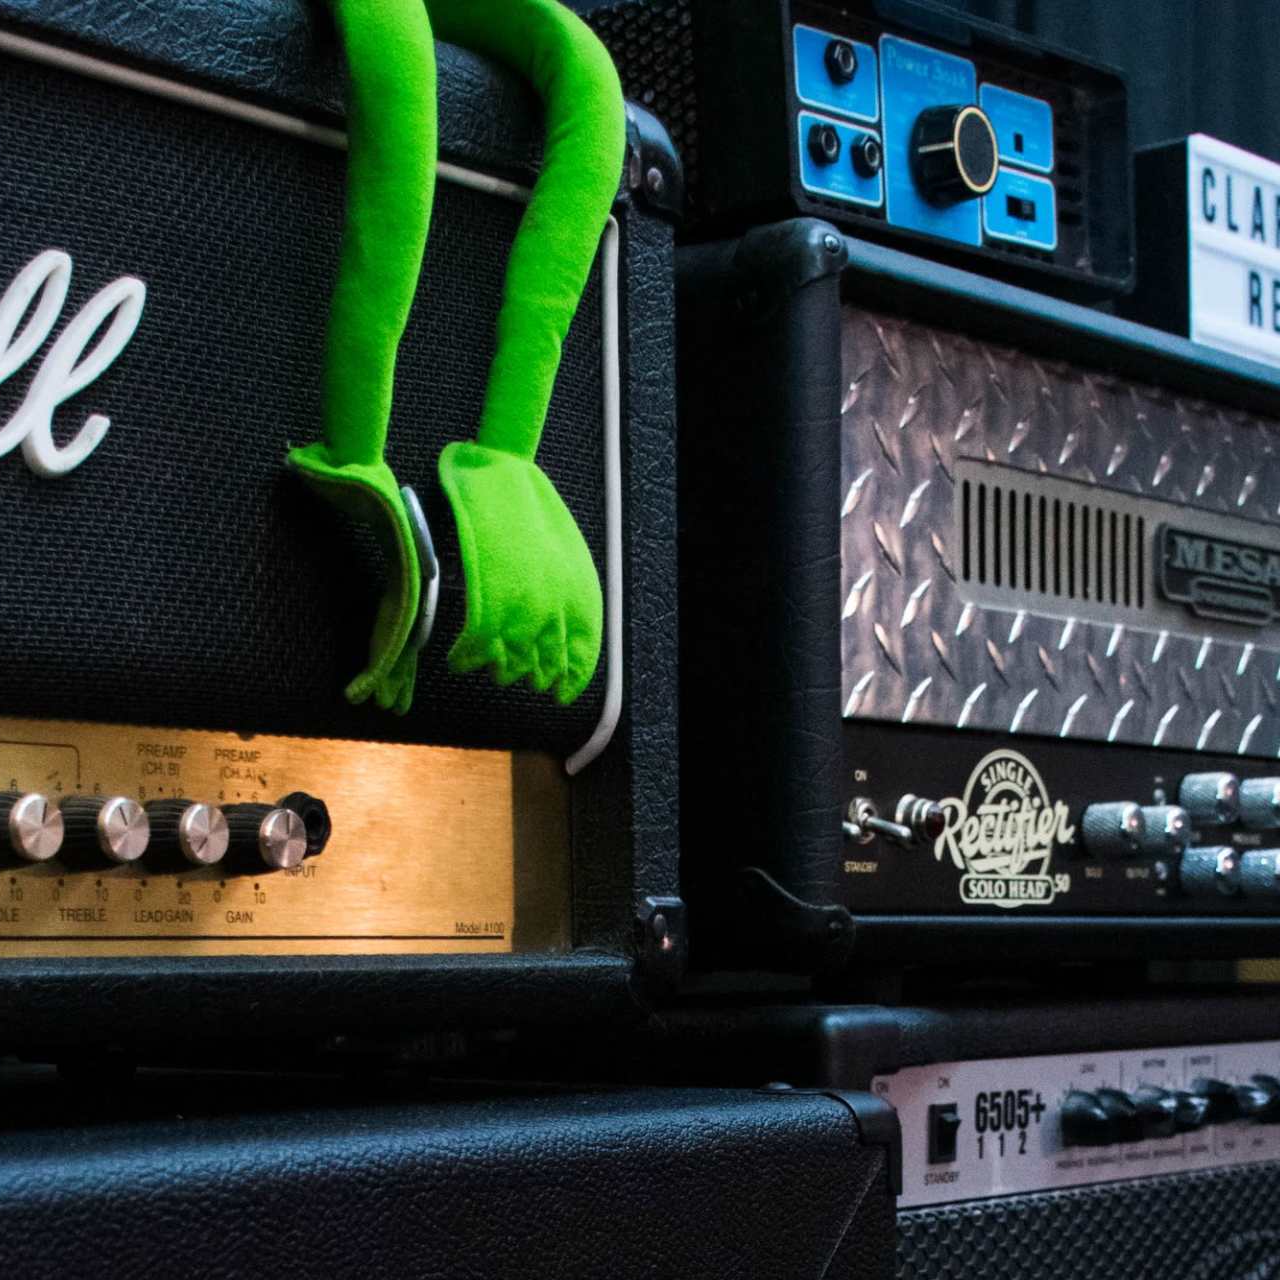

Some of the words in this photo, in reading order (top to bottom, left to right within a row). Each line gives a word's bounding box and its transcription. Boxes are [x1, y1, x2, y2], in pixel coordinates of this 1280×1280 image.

[137, 743, 187, 759] PREAMP
[214, 748, 261, 763] PREAMP
[854, 769, 868, 782] ON
[981, 761, 1033, 796] SINGLE
[934, 797, 1075, 872] Rectifier
[969, 880, 1008, 898] SOLO
[1009, 881, 1045, 898] HEAD
[1055, 874, 1070, 893] 50
[254, 891, 266, 905] 10
[59, 908, 107, 923] TREBLE
[134, 910, 163, 923] LEAD
[164, 910, 194, 923] GAIN
[225, 910, 255, 924] GAIN
[974, 1089, 1046, 1134] 6505+
[923, 1171, 961, 1186] STANDBY
